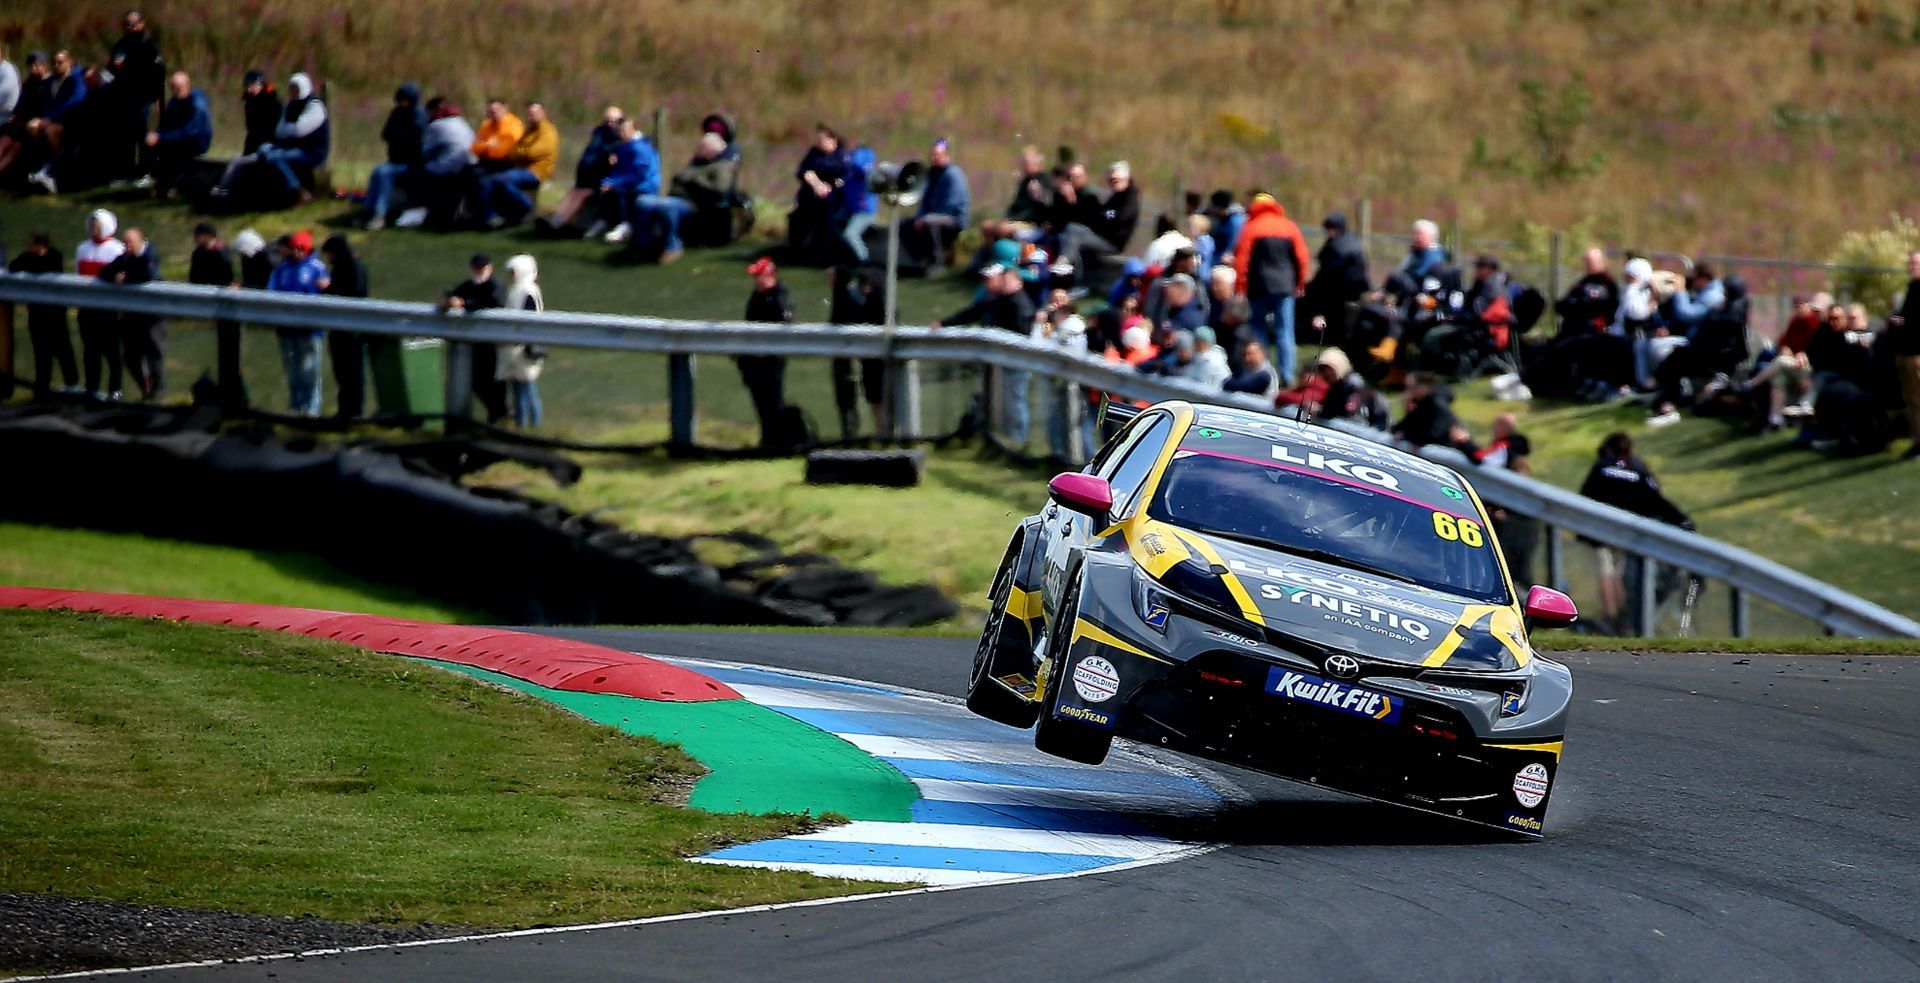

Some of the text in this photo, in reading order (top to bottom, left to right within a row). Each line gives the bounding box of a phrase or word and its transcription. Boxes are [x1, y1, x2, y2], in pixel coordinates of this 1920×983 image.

[1271, 444, 1402, 492] LKQ
[1432, 511, 1484, 548] 66
[1261, 584, 1429, 640] SYNETIQ
[1341, 617, 1362, 628] IAA
[1364, 624, 1415, 645] company
[1086, 659, 1112, 674] GKR
[1075, 669, 1117, 689] SCAFFOLDING
[1078, 683, 1106, 699] LIMITED
[1060, 705, 1108, 724] GOODYEAR
